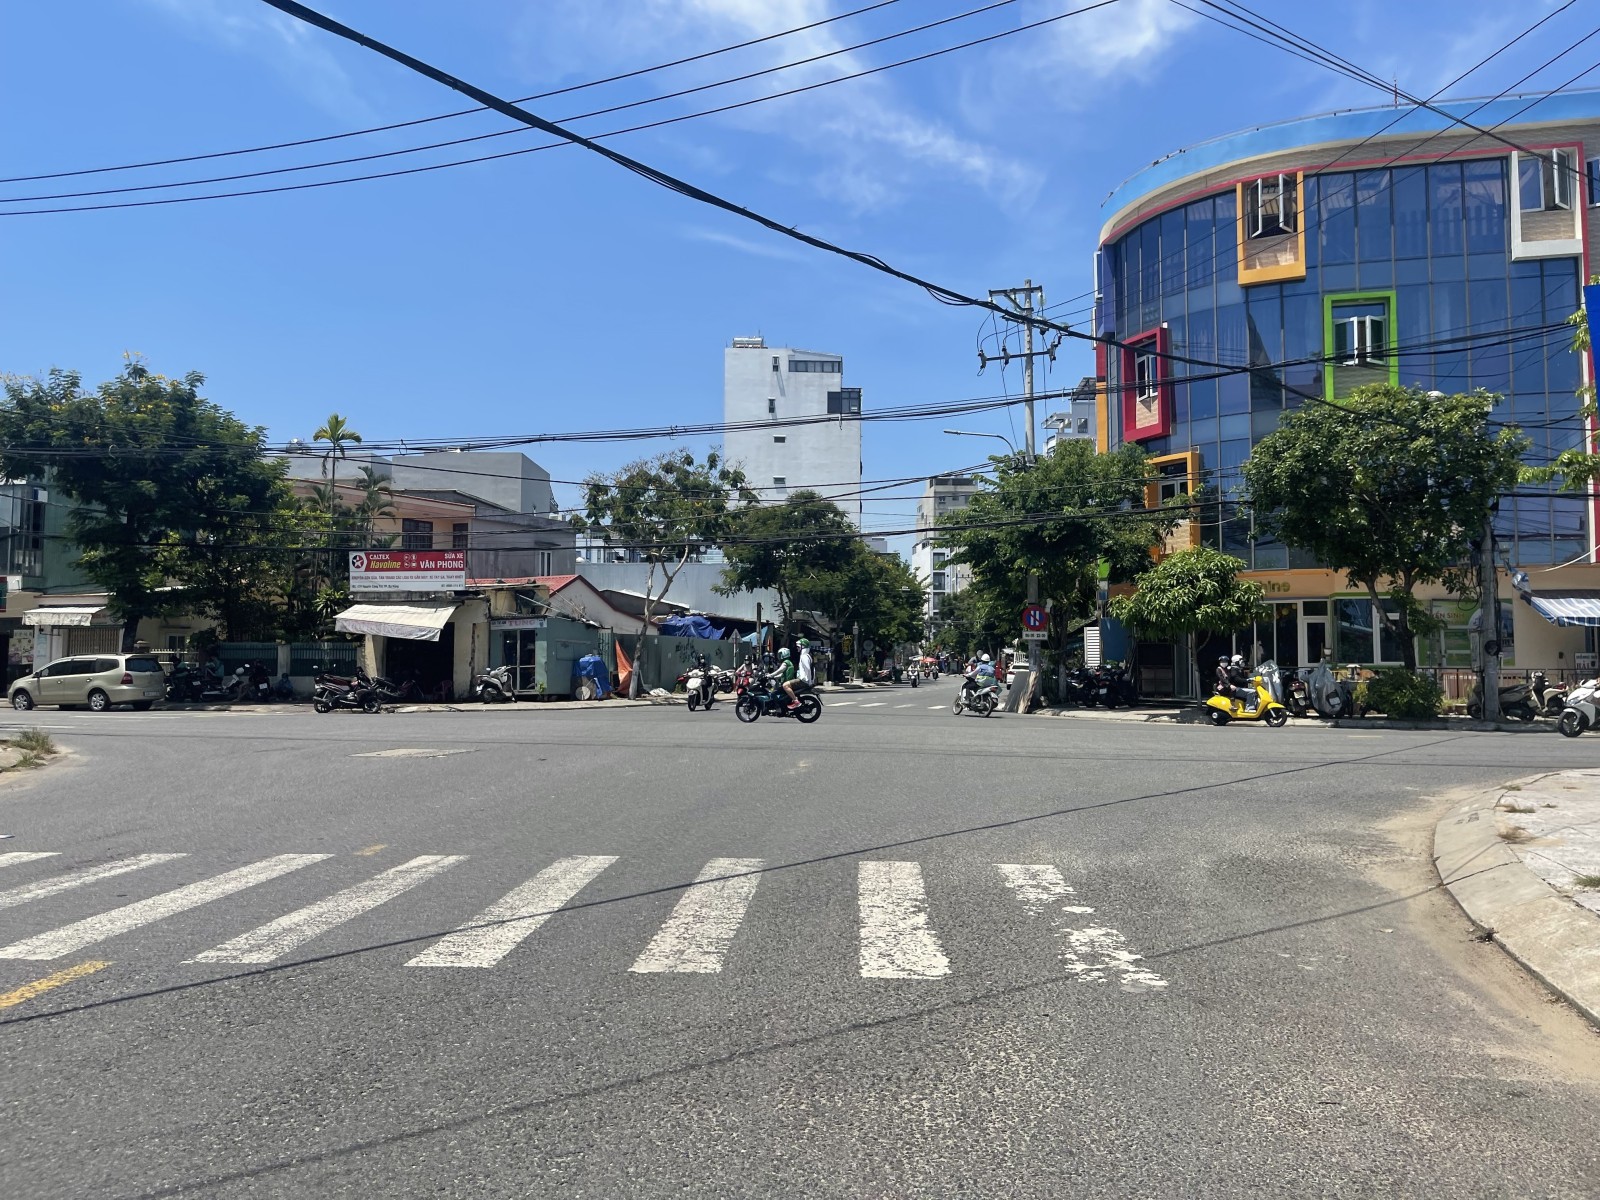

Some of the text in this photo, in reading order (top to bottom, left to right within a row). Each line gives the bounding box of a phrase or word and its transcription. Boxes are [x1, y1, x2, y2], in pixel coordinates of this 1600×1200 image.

[444, 551, 456, 559] SỬA
[369, 560, 401, 569] Havoline
[437, 560, 464, 569] PHONG
